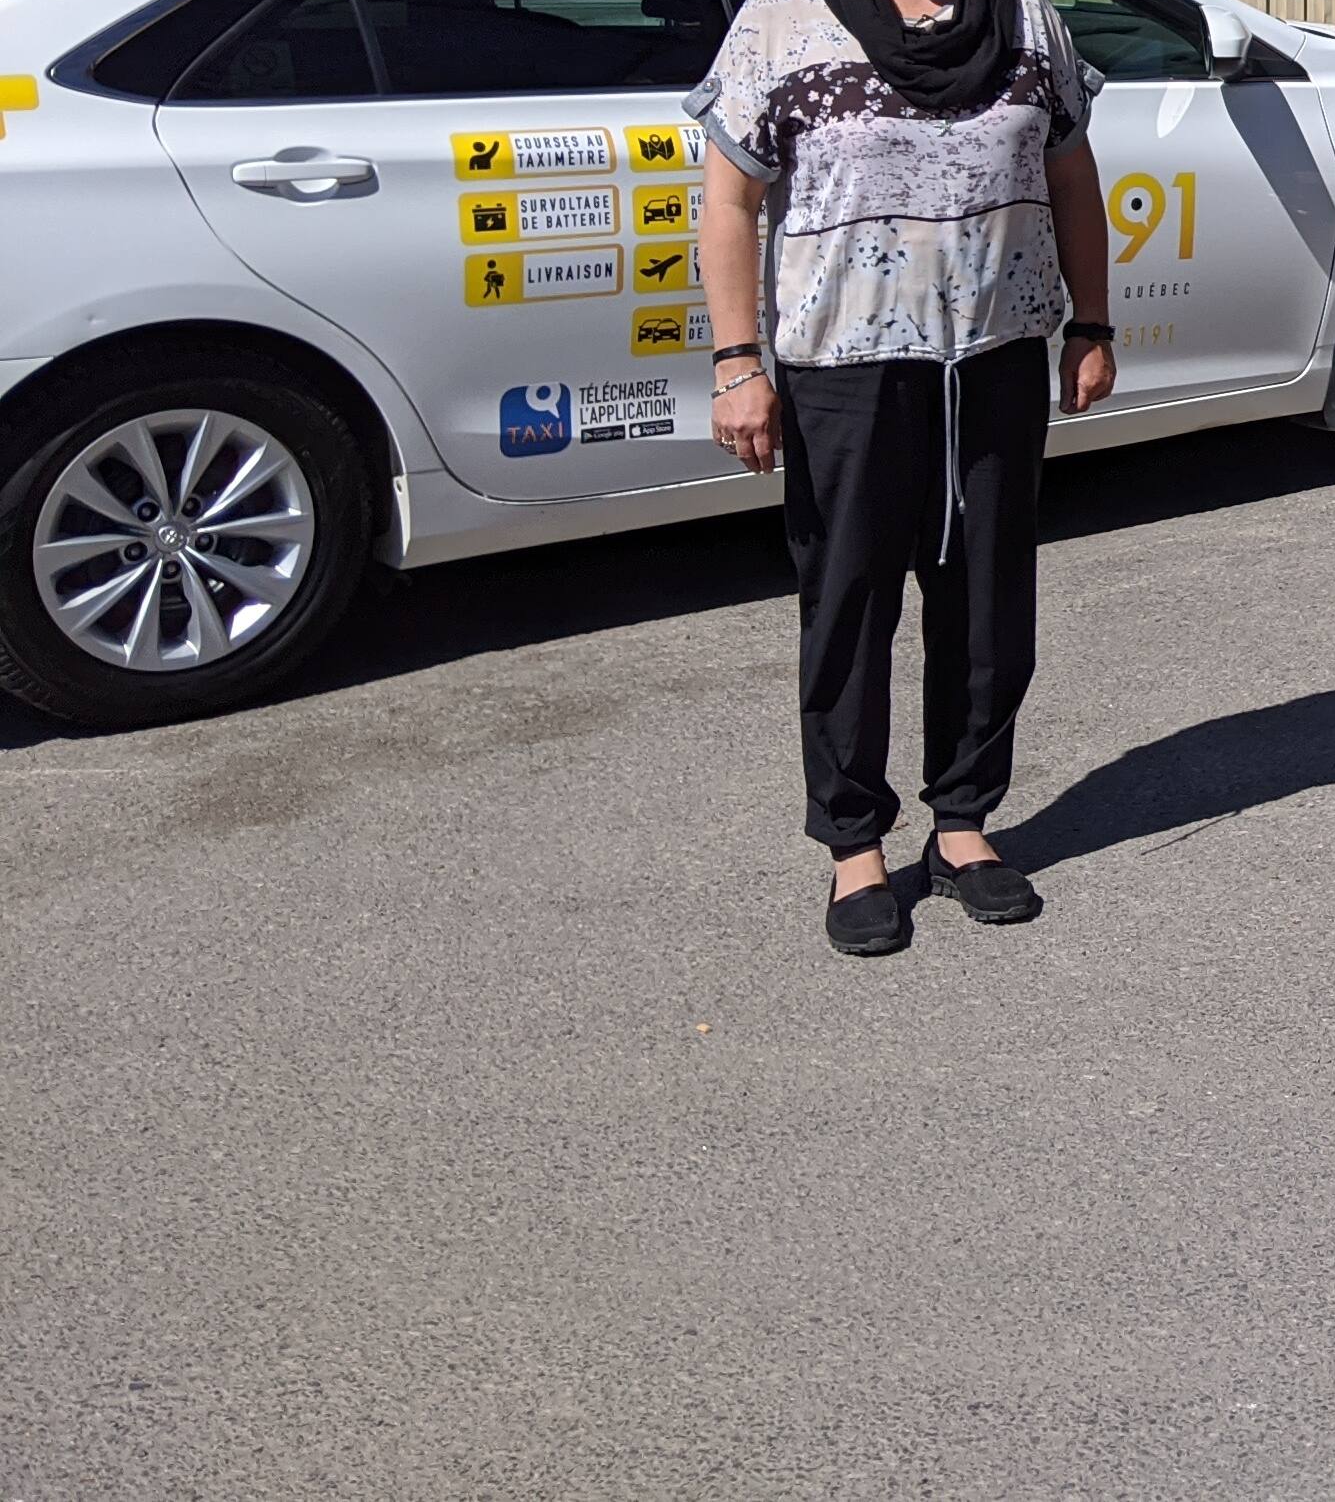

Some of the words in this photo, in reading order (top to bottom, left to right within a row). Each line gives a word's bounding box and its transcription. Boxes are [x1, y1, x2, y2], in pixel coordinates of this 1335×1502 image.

[514, 135, 579, 150] COURSES
[586, 134, 604, 147] AU
[517, 148, 606, 169] TAXIMÈTRE
[520, 194, 610, 214] SURVOLTAGE
[521, 216, 539, 230] DE
[546, 211, 611, 229] BATTERIE
[1108, 172, 1196, 264] 91
[528, 262, 613, 284] LIVRAISON
[1124, 281, 1190, 299] QUÉBEC
[688, 327, 703, 340] DE
[1123, 322, 1174, 347] 5191
[579, 378, 668, 405] TÉLÉCHARGEZ
[580, 397, 676, 425] L'APPLICATION!
[507, 421, 563, 445] TAXI
